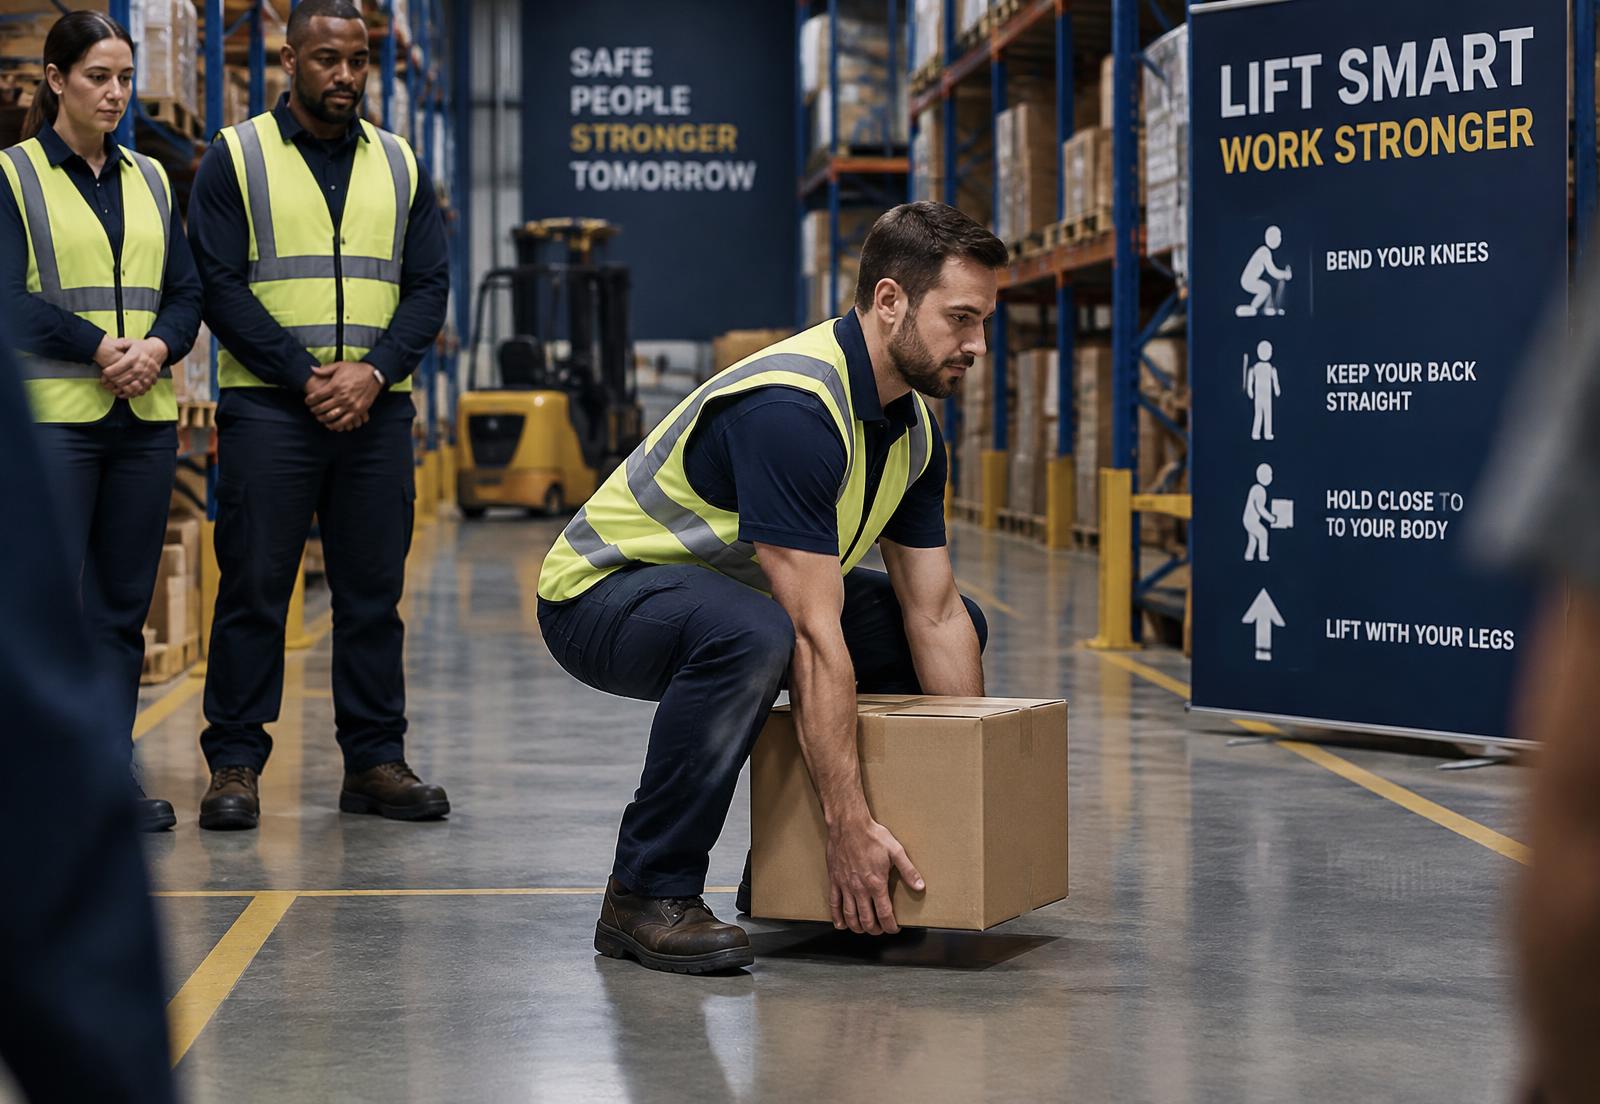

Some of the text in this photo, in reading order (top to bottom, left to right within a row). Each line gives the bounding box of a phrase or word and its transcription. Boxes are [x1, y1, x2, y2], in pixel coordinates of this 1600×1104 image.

[569, 46, 653, 78] SAFE
[1220, 26, 1535, 119] LIFT SMART
[569, 84, 691, 116] PEOPLE
[569, 122, 738, 154] STRONGER
[1219, 107, 1535, 175] WORK STRONGER
[568, 160, 757, 192] TOMORROW
[1326, 241, 1490, 272] BEND YOUR KNEES
[1326, 360, 1478, 385] KEEP YOUR BACK
[1326, 390, 1413, 412] STRAIGHT
[1326, 489, 1373, 511] HOLD
[1377, 490, 1435, 512] CLOSE
[1326, 516, 1449, 541] TO YOUR BODY
[1326, 618, 1515, 651] LIFT WITH YOUR LEGS
